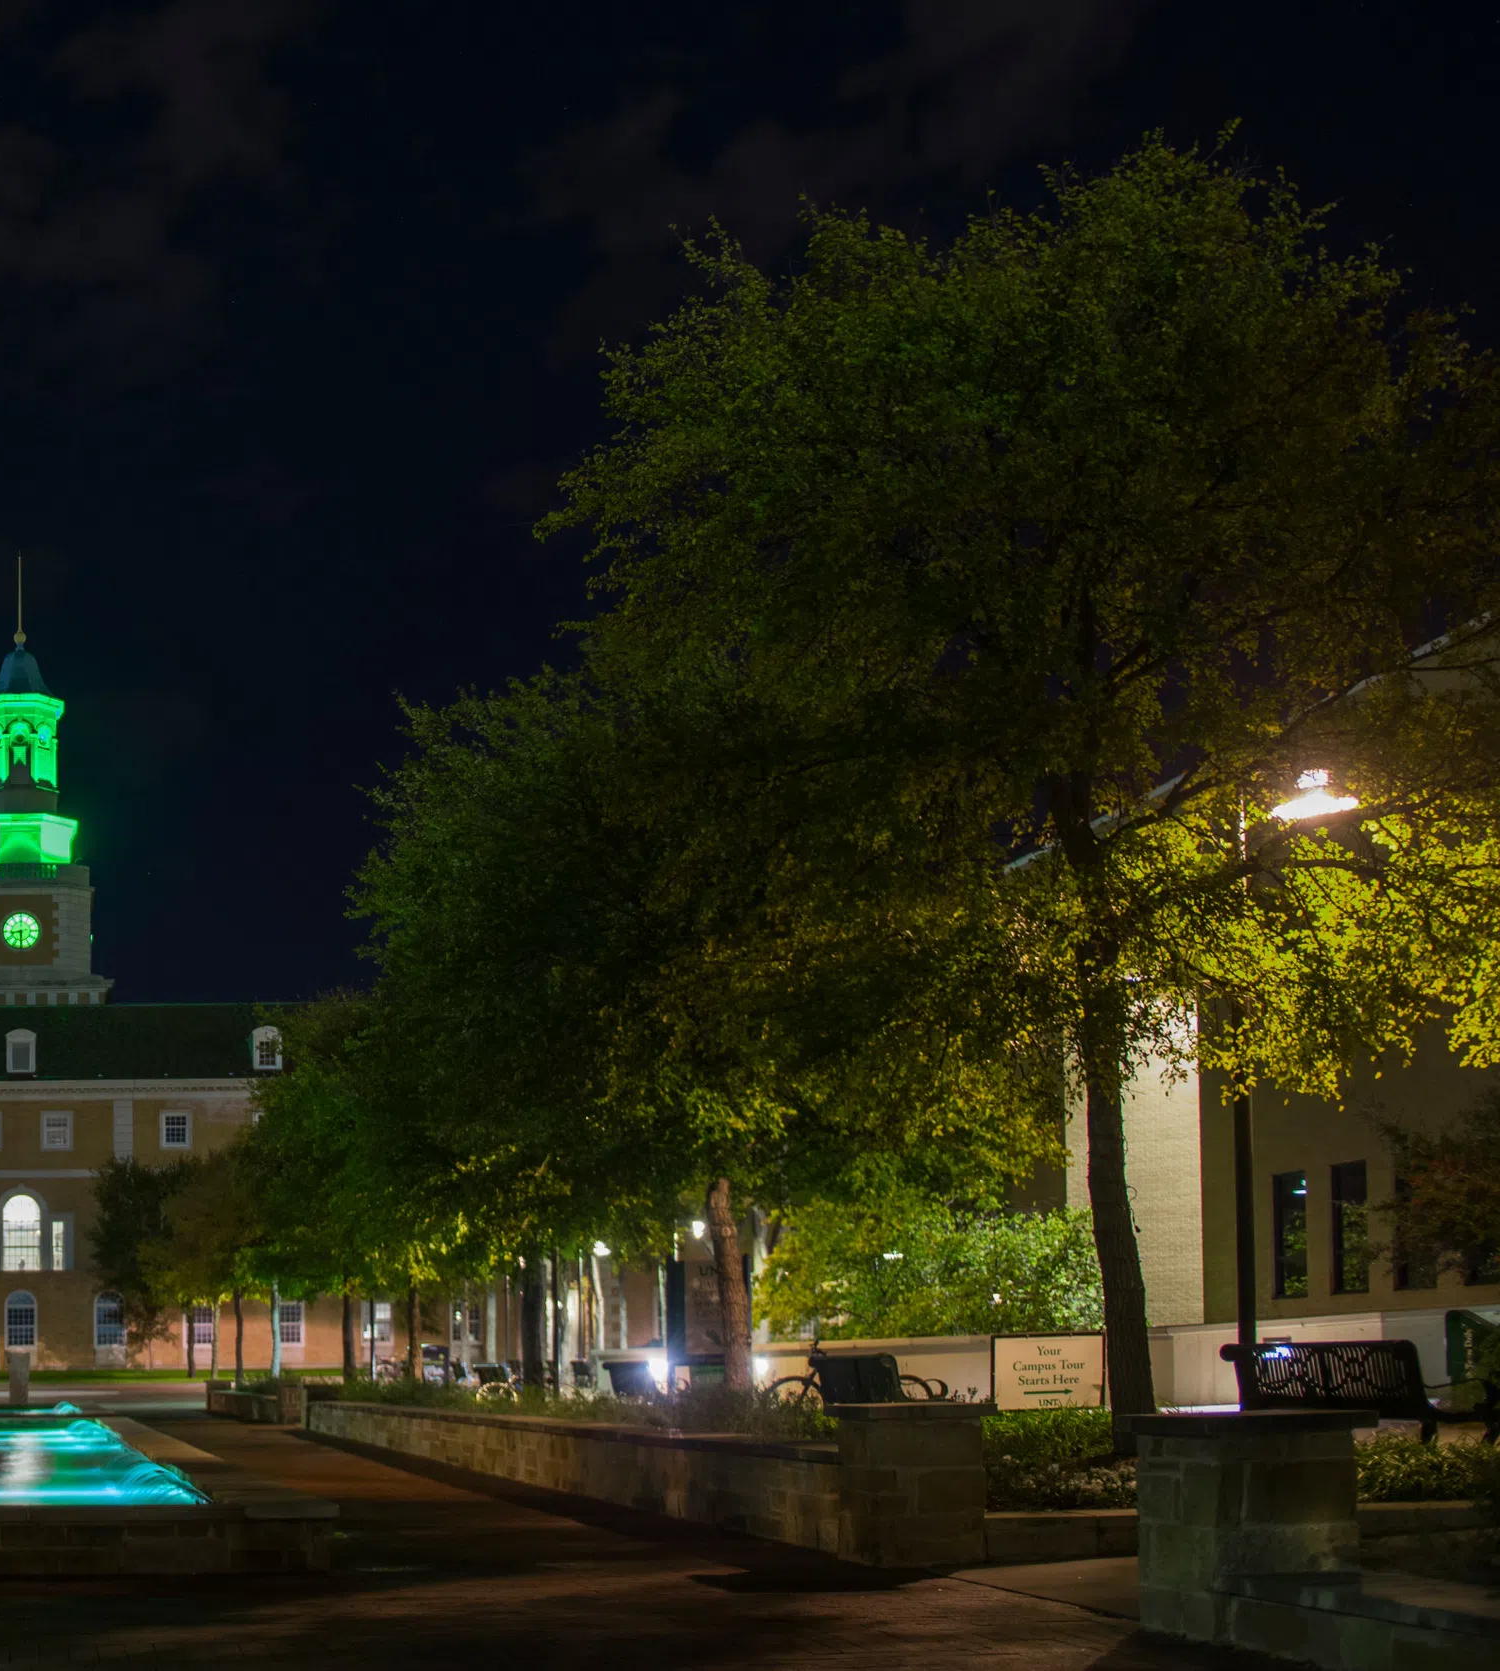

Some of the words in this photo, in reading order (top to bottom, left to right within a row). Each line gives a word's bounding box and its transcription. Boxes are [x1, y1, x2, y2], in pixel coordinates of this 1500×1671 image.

[697, 1265, 720, 1276] UN
[1036, 1345, 1062, 1356] Your
[1012, 1360, 1057, 1374] Campus
[1059, 1359, 1086, 1370] Tour
[1018, 1375, 1050, 1386] Starts
[1053, 1374, 1080, 1385] Here
[1038, 1398, 1059, 1407] UNT
